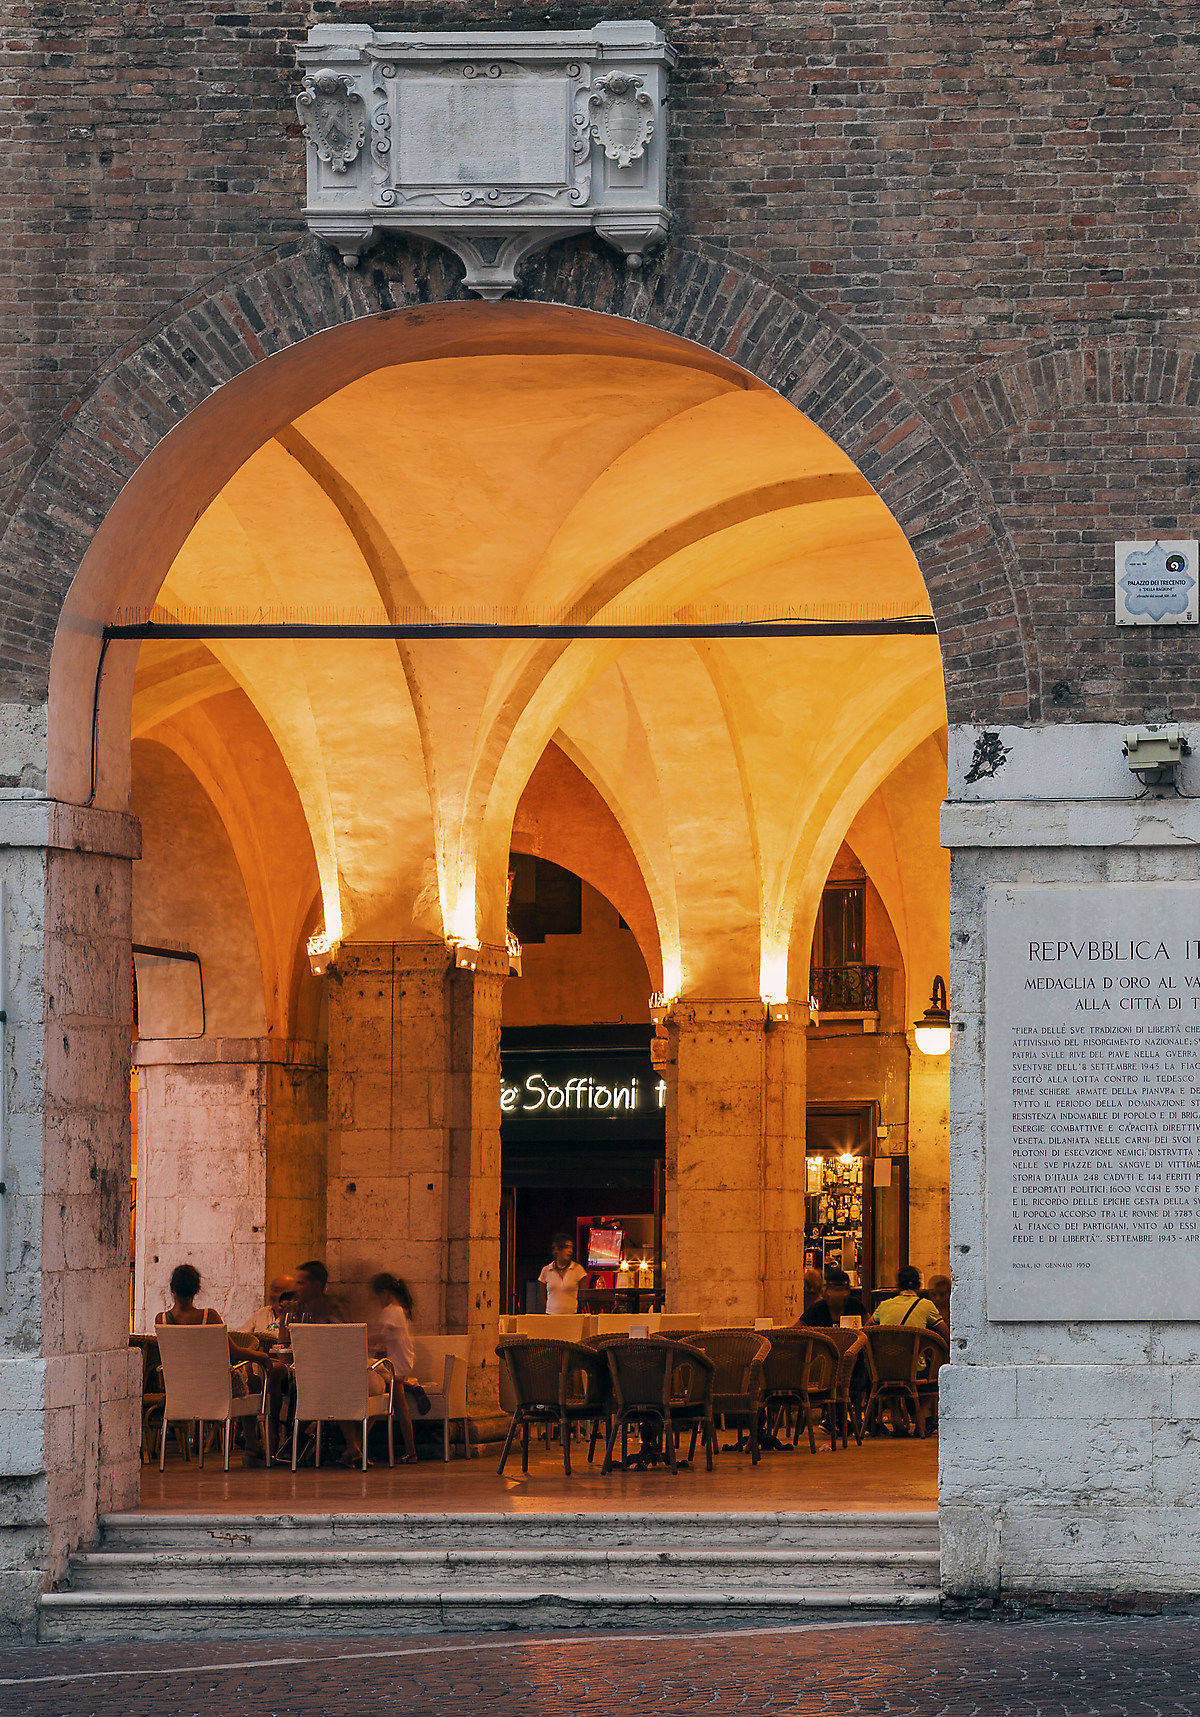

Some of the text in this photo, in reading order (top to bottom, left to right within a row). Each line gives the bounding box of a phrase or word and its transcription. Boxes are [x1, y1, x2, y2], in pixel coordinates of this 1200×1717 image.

[1029, 941, 1170, 960] REPVBBLICA
[1024, 978, 1095, 989] MEDAGLIA
[1102, 977, 1150, 988] D'ORO
[1158, 977, 1177, 988] AL
[1075, 999, 1111, 1010] ALLA
[1120, 995, 1161, 1009] CITTÀ
[1169, 998, 1181, 1009] DI
[1070, 1026, 1085, 1034] SVE
[1090, 1026, 1132, 1034] TRADIZIONI
[1136, 1025, 1143, 1033] DI
[1185, 1025, 1200, 1033] CHE
[1065, 1038, 1079, 1046] DEL
[1083, 1038, 1140, 1046] RISORGIMENTO
[1013, 1063, 1052, 1071] SVENTVRE
[1091, 1062, 1137, 1070] SETTEMBRE
[1142, 1062, 1159, 1070] 1943
[1165, 1062, 1175, 1070] LA
[523, 1074, 637, 1110] Soffioni
[1013, 1100, 1040, 1108] TVTTO
[1044, 1100, 1051, 1108] IL
[1057, 1100, 1091, 1108] PERIODO
[1096, 1099, 1122, 1107] DELLA
[1128, 1099, 1185, 1107] DOMINAZIONE
[1012, 1112, 1056, 1120] RESISTENZA
[1061, 1112, 1108, 1120] INDOMABILE
[1112, 1112, 1119, 1120] DI
[1124, 1111, 1156, 1119] POPOLO
[1169, 1111, 1177, 1119] DI
[1012, 1124, 1045, 1132] ENERGIE
[1050, 1124, 1103, 1132] COMBATTIVE
[1049, 1136, 1090, 1144] DILANIATA
[1095, 1136, 1120, 1144] NELLE
[1155, 1136, 1167, 1144] DEI
[1173, 1136, 1191, 1144] SVOI
[892, 1142, 903, 1150] 27
[1013, 1149, 1047, 1157] PLOTONI
[1052, 1149, 1059, 1157] DI
[1065, 1148, 1112, 1156] ESECVZIONE
[1117, 1149, 1148, 1157] NEMICI;
[1149, 1148, 1193, 1156] DISTRVTTA
[1013, 1161, 1038, 1169] NELLE
[1044, 1161, 1058, 1169] SVE
[1063, 1161, 1092, 1169] PIAZZE
[1097, 1161, 1113, 1169] DAL
[1119, 1160, 1150, 1168] SANGVE
[1155, 1160, 1163, 1168] DI
[1013, 1173, 1041, 1181] STORIA
[1045, 1173, 1079, 1181] D'ITALIA
[1084, 1173, 1099, 1181] 248
[1103, 1173, 1134, 1181] CADVTI
[1148, 1173, 1161, 1181] 144
[1166, 1172, 1191, 1180] FERITI
[1022, 1185, 1065, 1193] DEPORTATI
[1135, 1185, 1161, 1193] VCCISI
[1174, 1185, 1190, 1193] 350
[1021, 1198, 1028, 1206] IL
[1073, 1197, 1098, 1205] DELLE
[1103, 1197, 1130, 1205] EPICHE
[1134, 1197, 1159, 1205] GESTA
[1164, 1197, 1189, 1205] DELLA
[1013, 1235, 1034, 1243] FEDE
[1049, 1234, 1057, 1242] DI
[1106, 1234, 1153, 1242] SETTEMBRE
[1159, 1234, 1176, 1242] 1943
